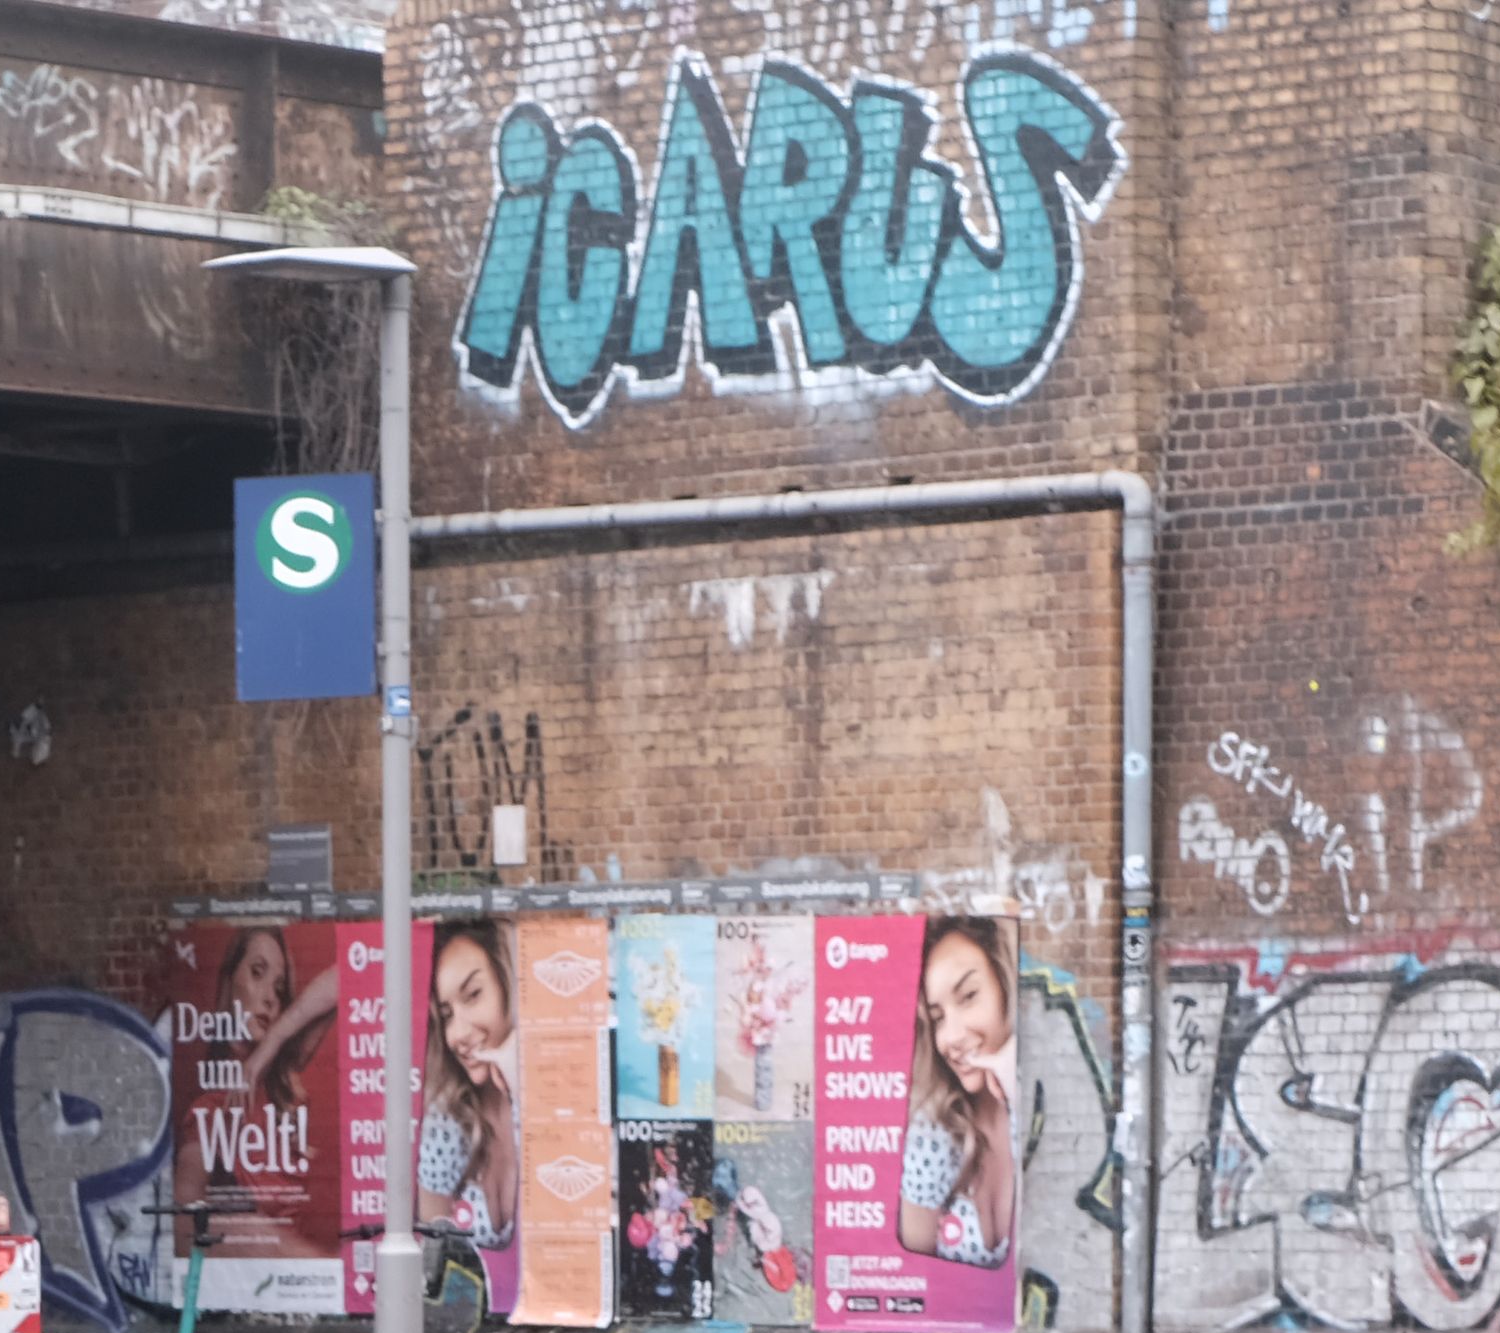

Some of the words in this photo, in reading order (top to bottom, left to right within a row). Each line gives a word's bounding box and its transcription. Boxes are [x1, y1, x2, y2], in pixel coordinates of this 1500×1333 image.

[270, 497, 339, 588] S
[717, 921, 749, 939] 100
[177, 999, 253, 1042] Denk
[825, 997, 873, 1025] 24/7
[825, 1034, 873, 1062] LIVE
[825, 1071, 907, 1100] SHOWS
[193, 1103, 310, 1173] Welt!
[618, 1121, 652, 1142] 100
[825, 1125, 903, 1153] PRIVAT
[825, 1163, 876, 1190] UND
[825, 1201, 886, 1229] HEISS
